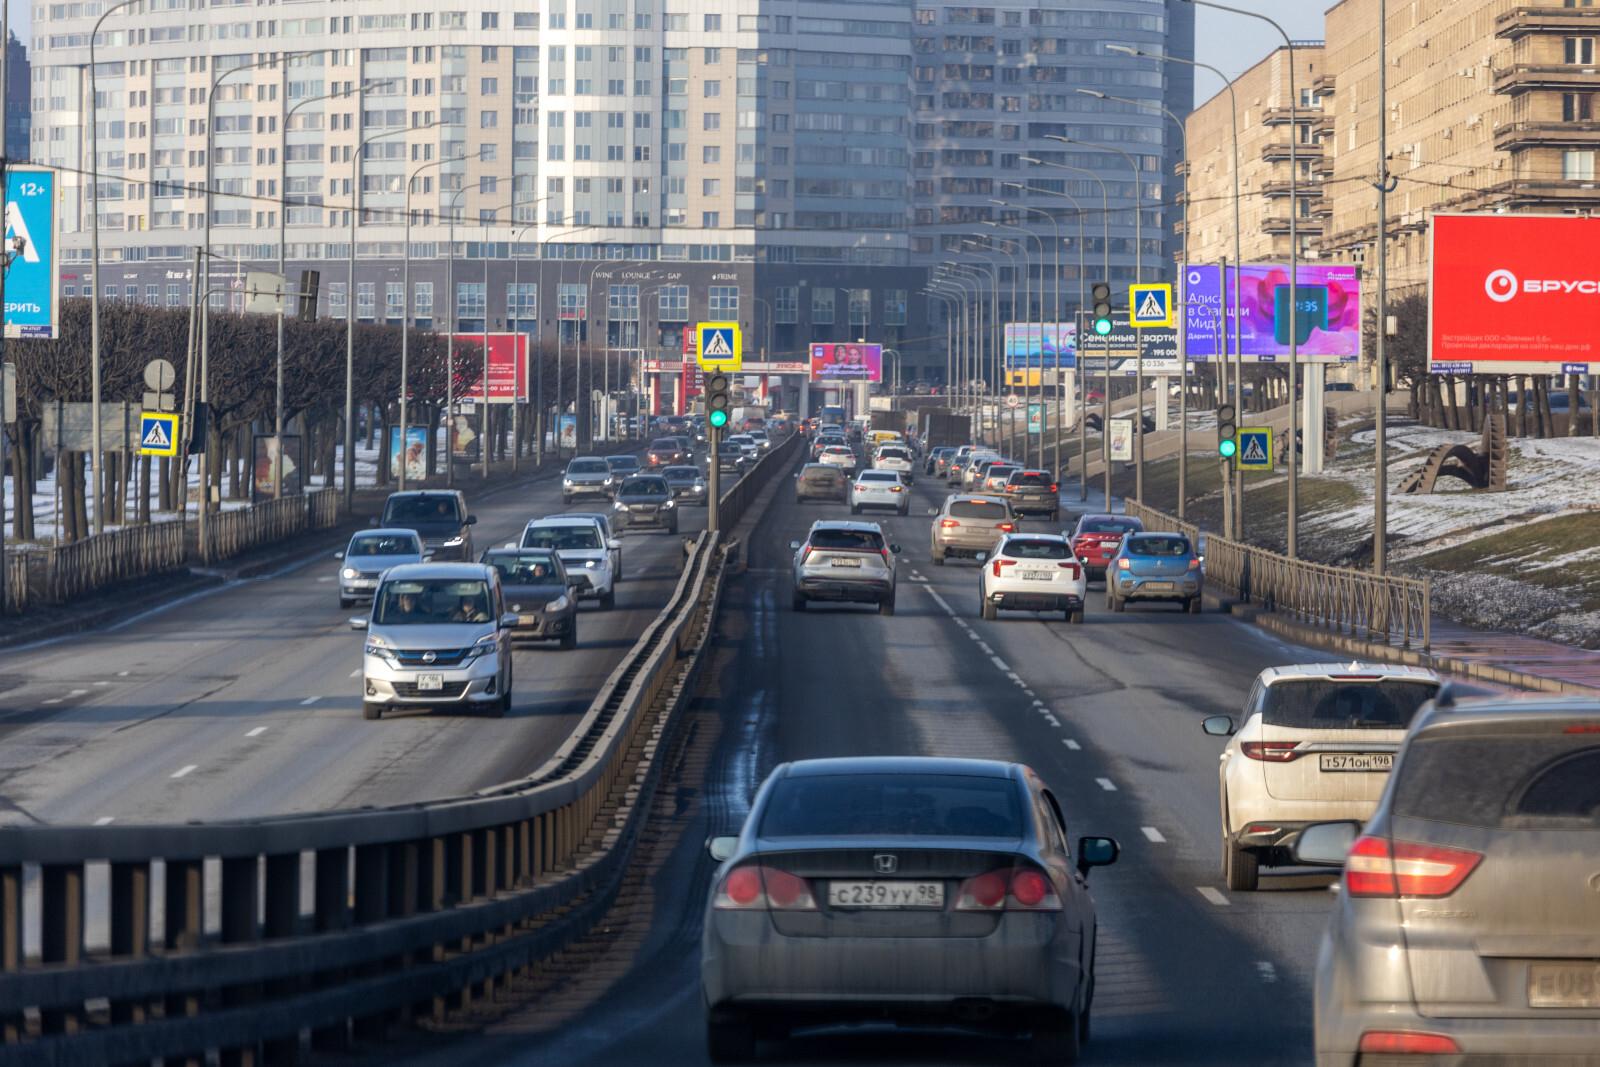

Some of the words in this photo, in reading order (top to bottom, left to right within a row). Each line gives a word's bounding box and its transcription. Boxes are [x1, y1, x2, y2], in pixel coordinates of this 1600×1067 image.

[20, 183, 45, 196] 12+
[1523, 279, 1600, 294] БРУС
[1188, 293, 1222, 304] Алис
